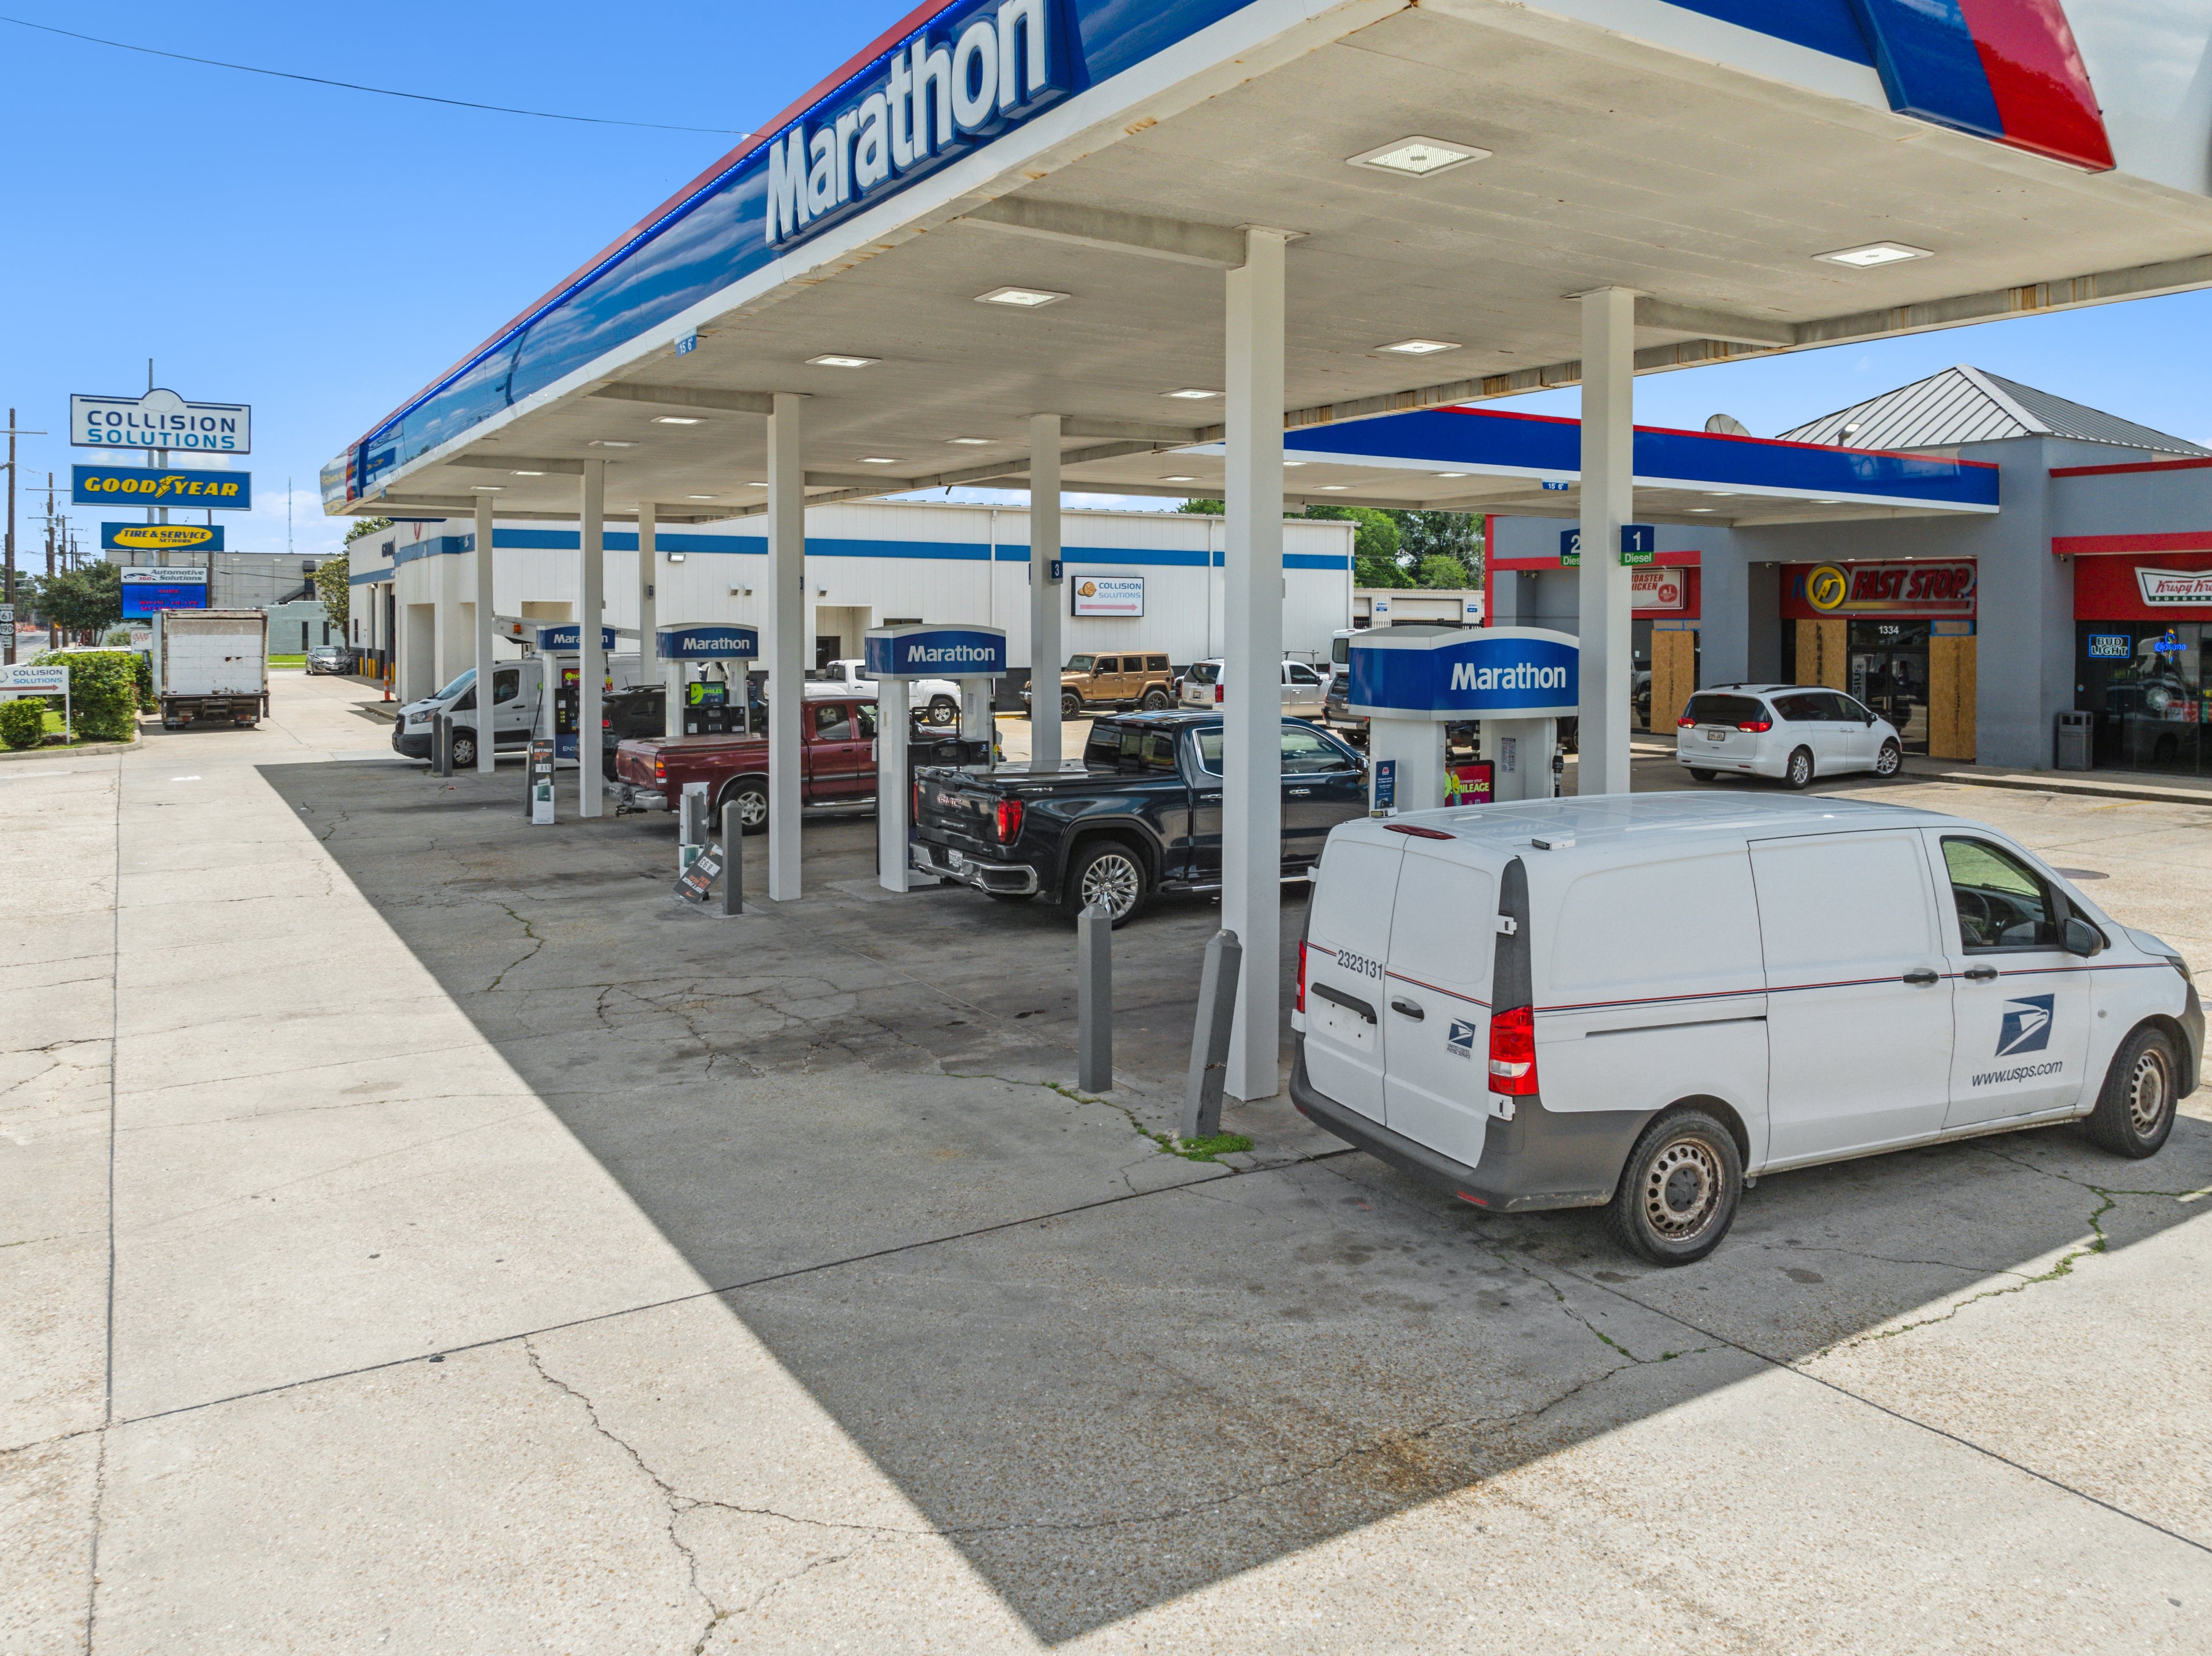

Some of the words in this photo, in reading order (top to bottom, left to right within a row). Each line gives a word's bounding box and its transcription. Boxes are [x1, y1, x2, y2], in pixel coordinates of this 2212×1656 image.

[766, 0, 1046, 244] Marathon
[88, 411, 235, 433] COLLISION
[88, 429, 234, 449] SOLUTIONS
[160, 531, 207, 539] SERVICE
[1571, 535, 1580, 554] 2
[1633, 532, 1641, 551] 1
[1563, 556, 1580, 566] Dies
[1624, 553, 1652, 563] Diesel
[1055, 564, 1059, 576] 3
[1631, 574, 1664, 582] OASTER
[1631, 582, 1657, 591] HICKEN
[1850, 569, 1908, 600] FAST
[2155, 580, 2195, 595] Krispy
[2194, 579, 2212, 593] Kre
[1878, 626, 1899, 634] 1334
[554, 634, 608, 643] Maran
[683, 638, 750, 650] Marathon
[2096, 637, 2123, 646] BUD
[2091, 646, 2128, 656] LIGHT
[2154, 641, 2187, 653] Corona
[907, 645, 995, 662] Marathon
[1450, 662, 1566, 690] Marathon
[937, 795, 963, 809] GMC
[681, 876, 695, 887] PACK
[692, 883, 704, 895] SOFT
[1338, 949, 1382, 980] 2323131
[1972, 1061, 2063, 1087] www.usps.com
